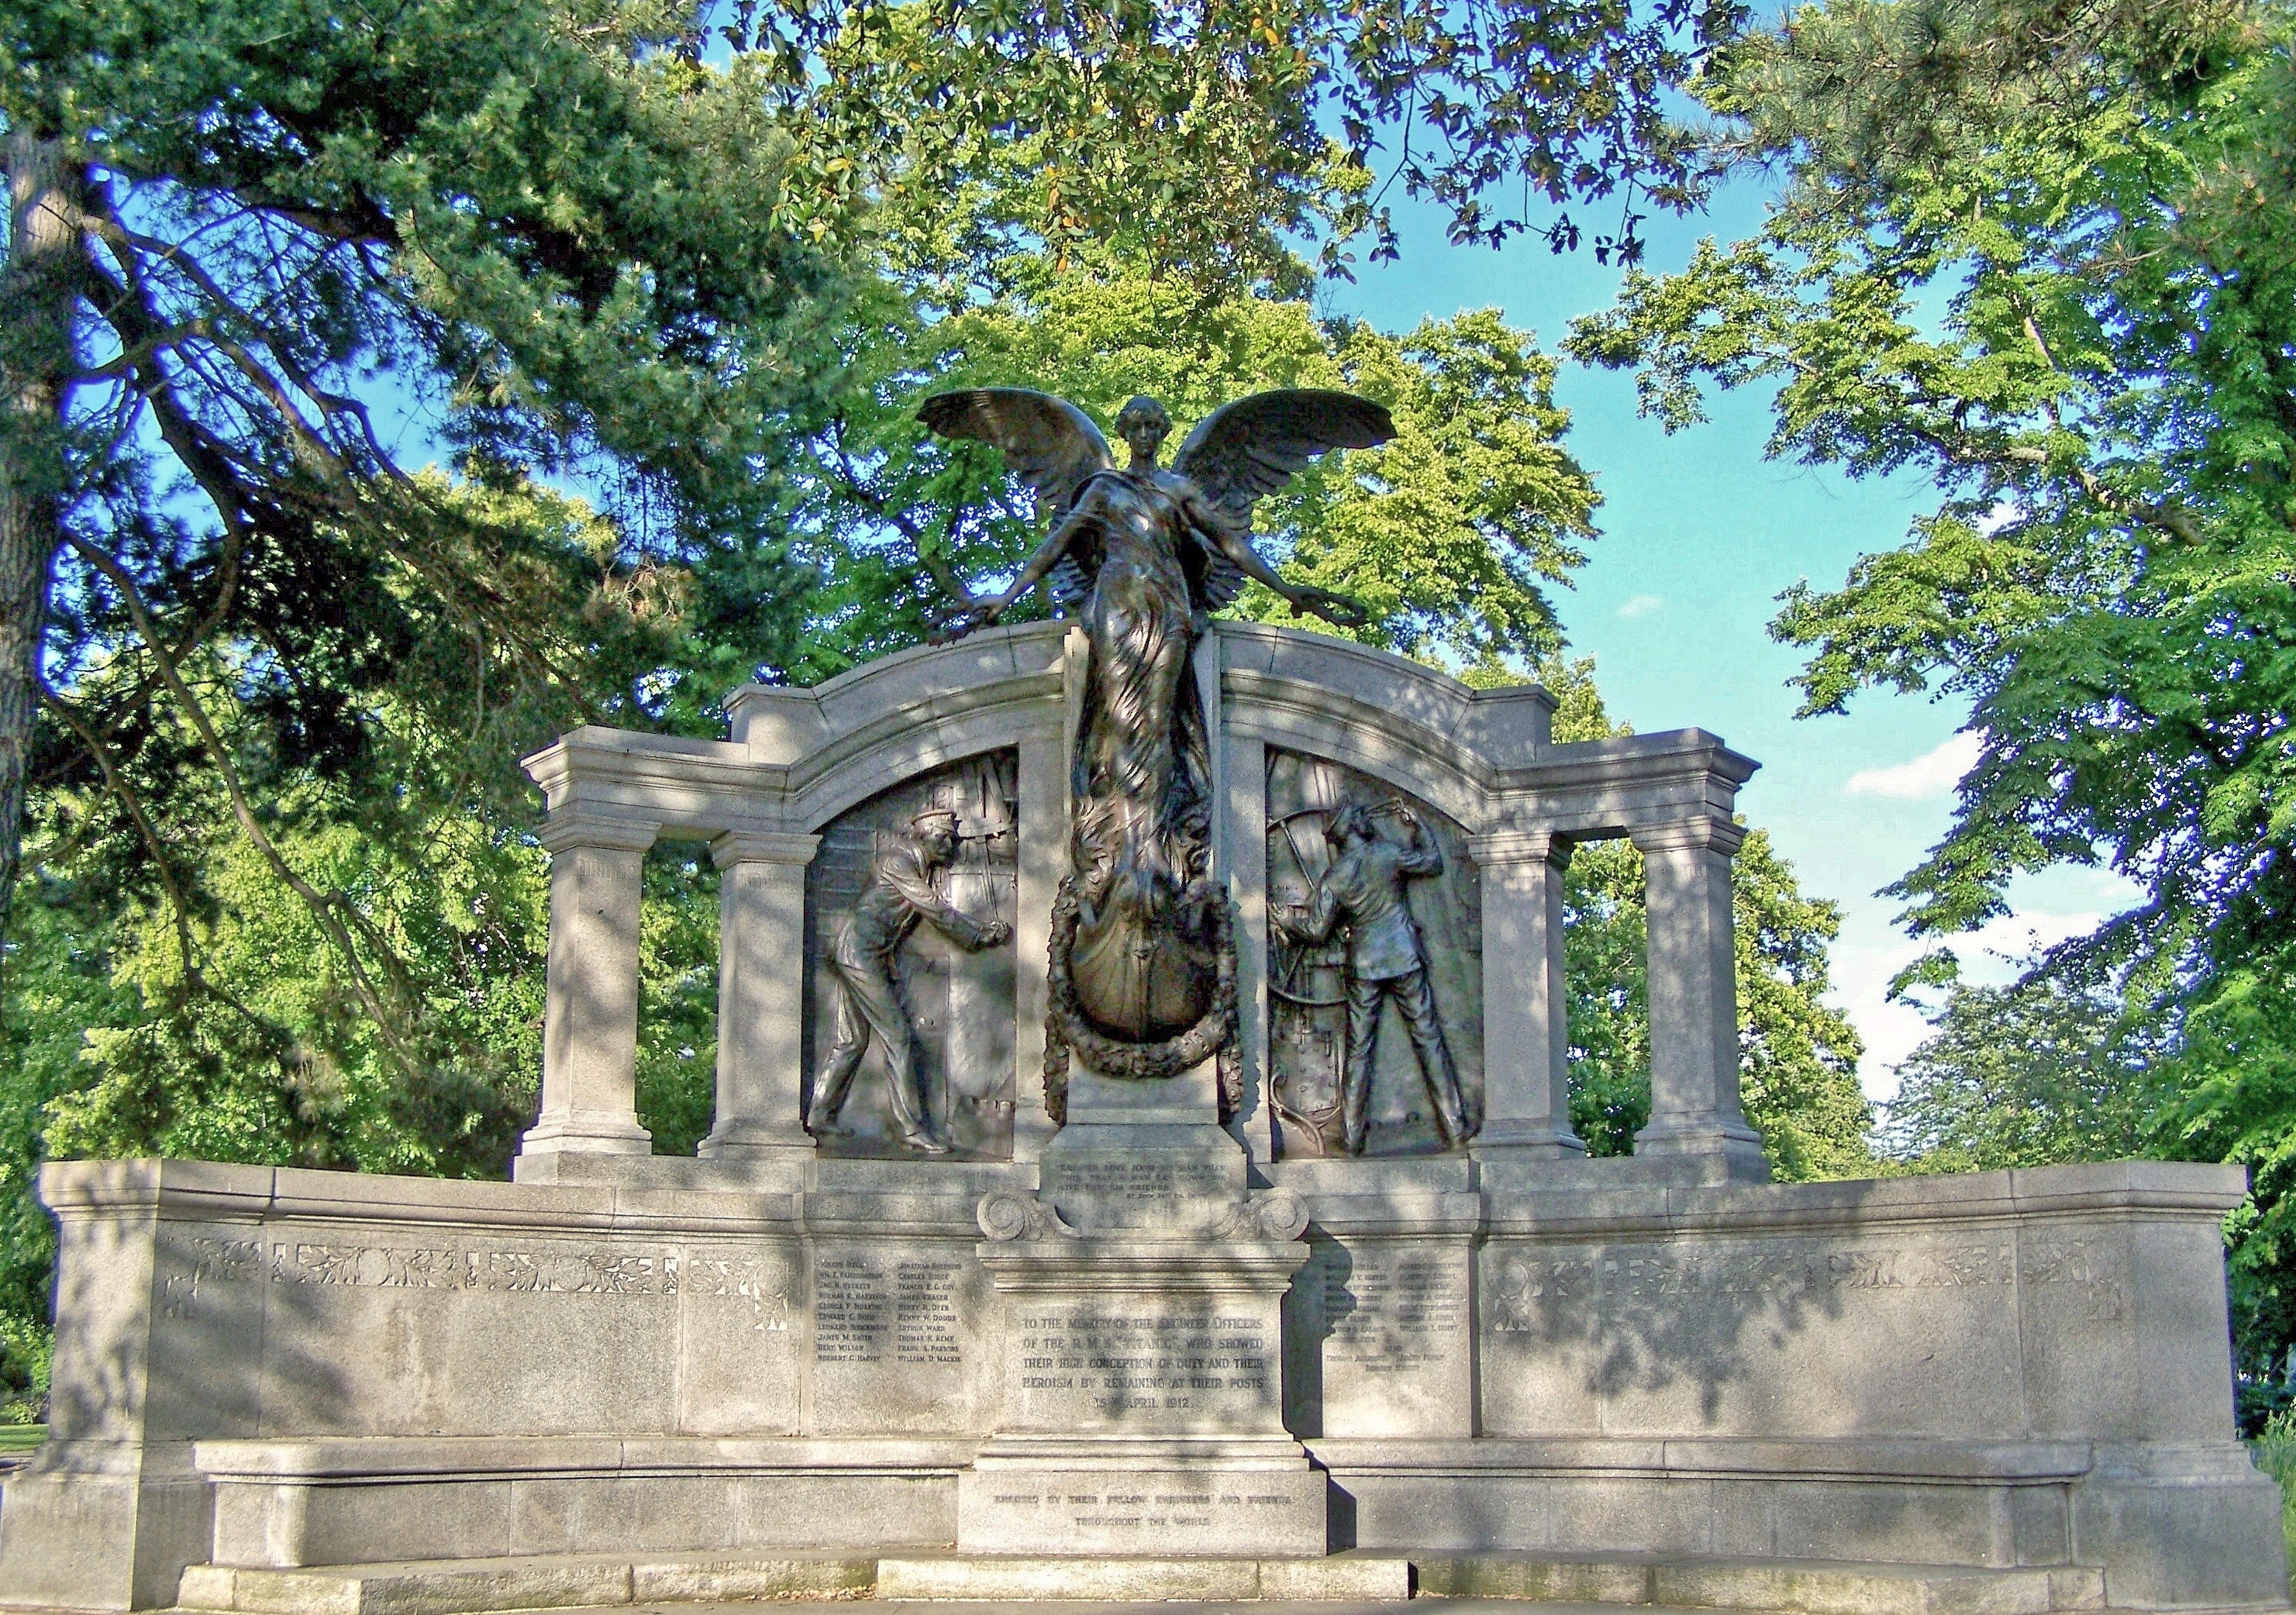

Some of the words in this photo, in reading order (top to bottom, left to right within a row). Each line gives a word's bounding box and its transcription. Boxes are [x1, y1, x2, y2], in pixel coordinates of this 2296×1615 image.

[1022, 1318, 1037, 1329] TO
[1042, 1318, 1062, 1329] THE
[1132, 1318, 1153, 1329] THE
[1212, 1318, 1263, 1329] OFFICERS
[1023, 1338, 1037, 1349] OF
[1023, 1358, 1053, 1369] THEIR
[1088, 1358, 1153, 1369] CONCEPTION
[1176, 1358, 1205, 1369] DUTY
[1208, 1358, 1230, 1369] AND
[1232, 1358, 1264, 1369] THEIR
[1022, 1377, 1074, 1389] HEROISM
[1103, 1377, 1165, 1389] REMAINING
[1191, 1377, 1222, 1389] THEIR
[1067, 1495, 1098, 1504] THEIR
